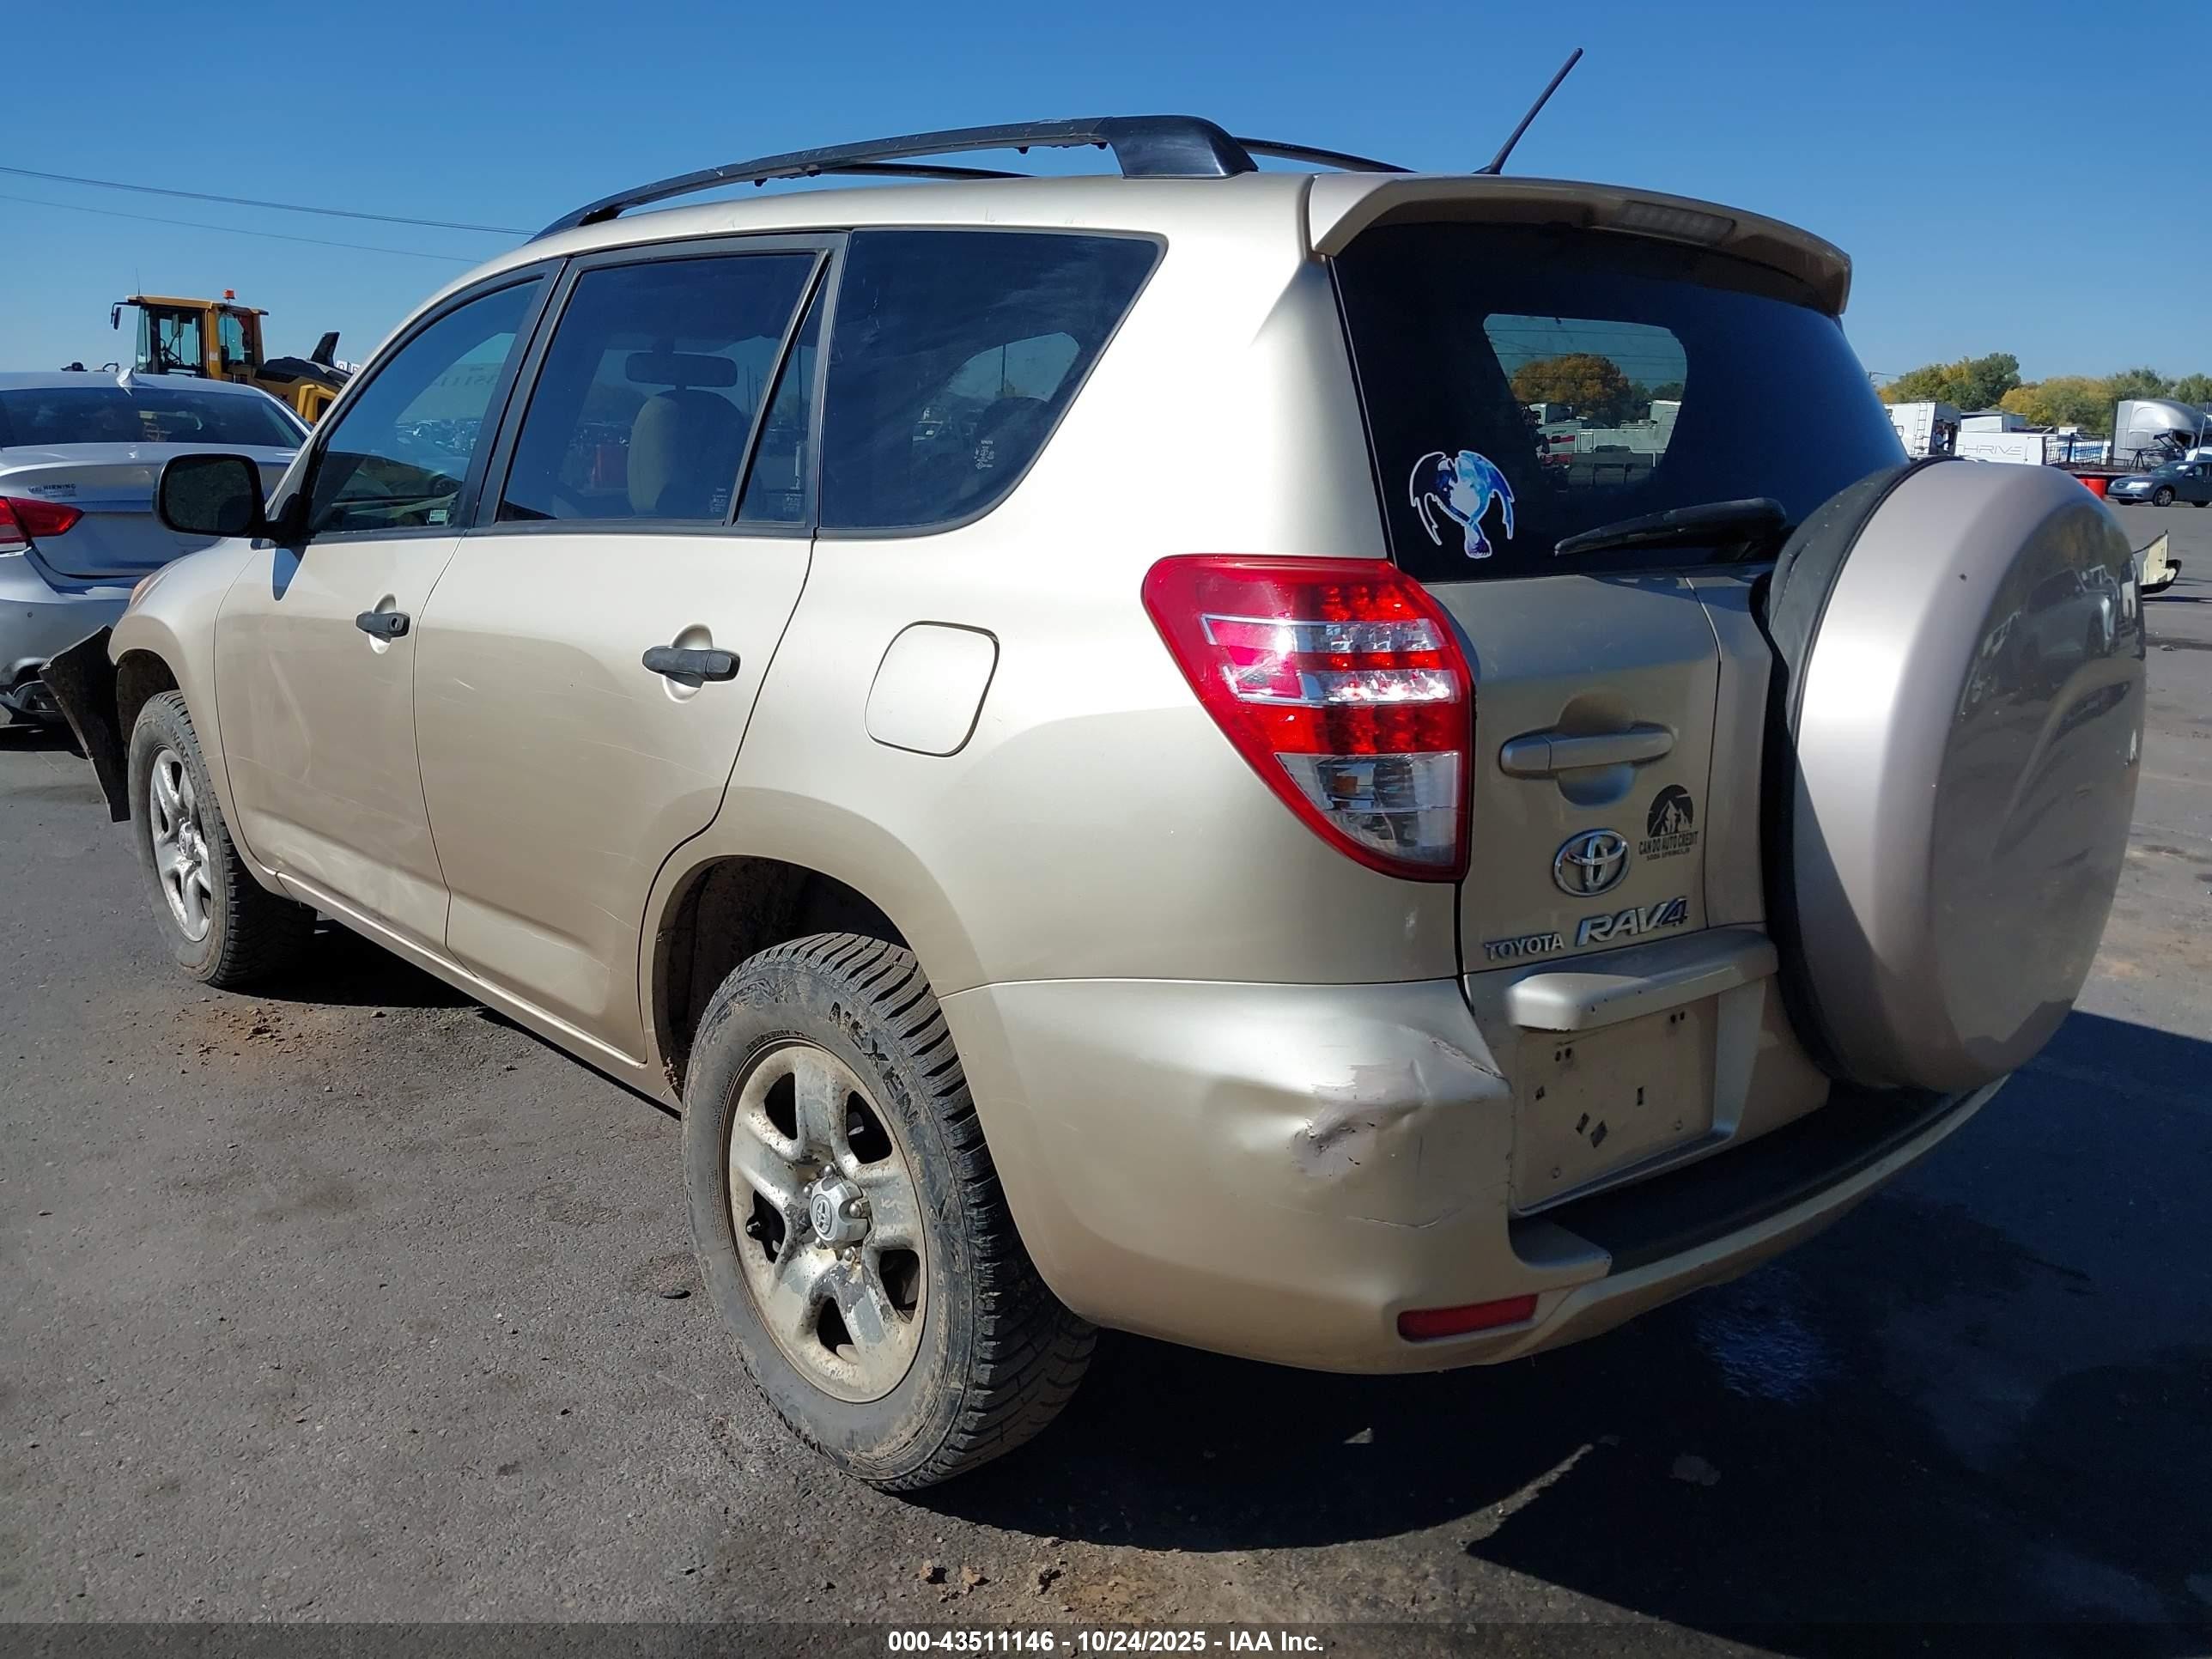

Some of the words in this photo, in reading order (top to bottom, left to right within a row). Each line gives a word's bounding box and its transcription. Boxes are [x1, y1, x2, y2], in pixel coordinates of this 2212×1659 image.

[1485, 933, 1565, 961] TOYOTA
[1576, 896, 1689, 947] RAV4
[829, 1001, 919, 1127] NEXEN
